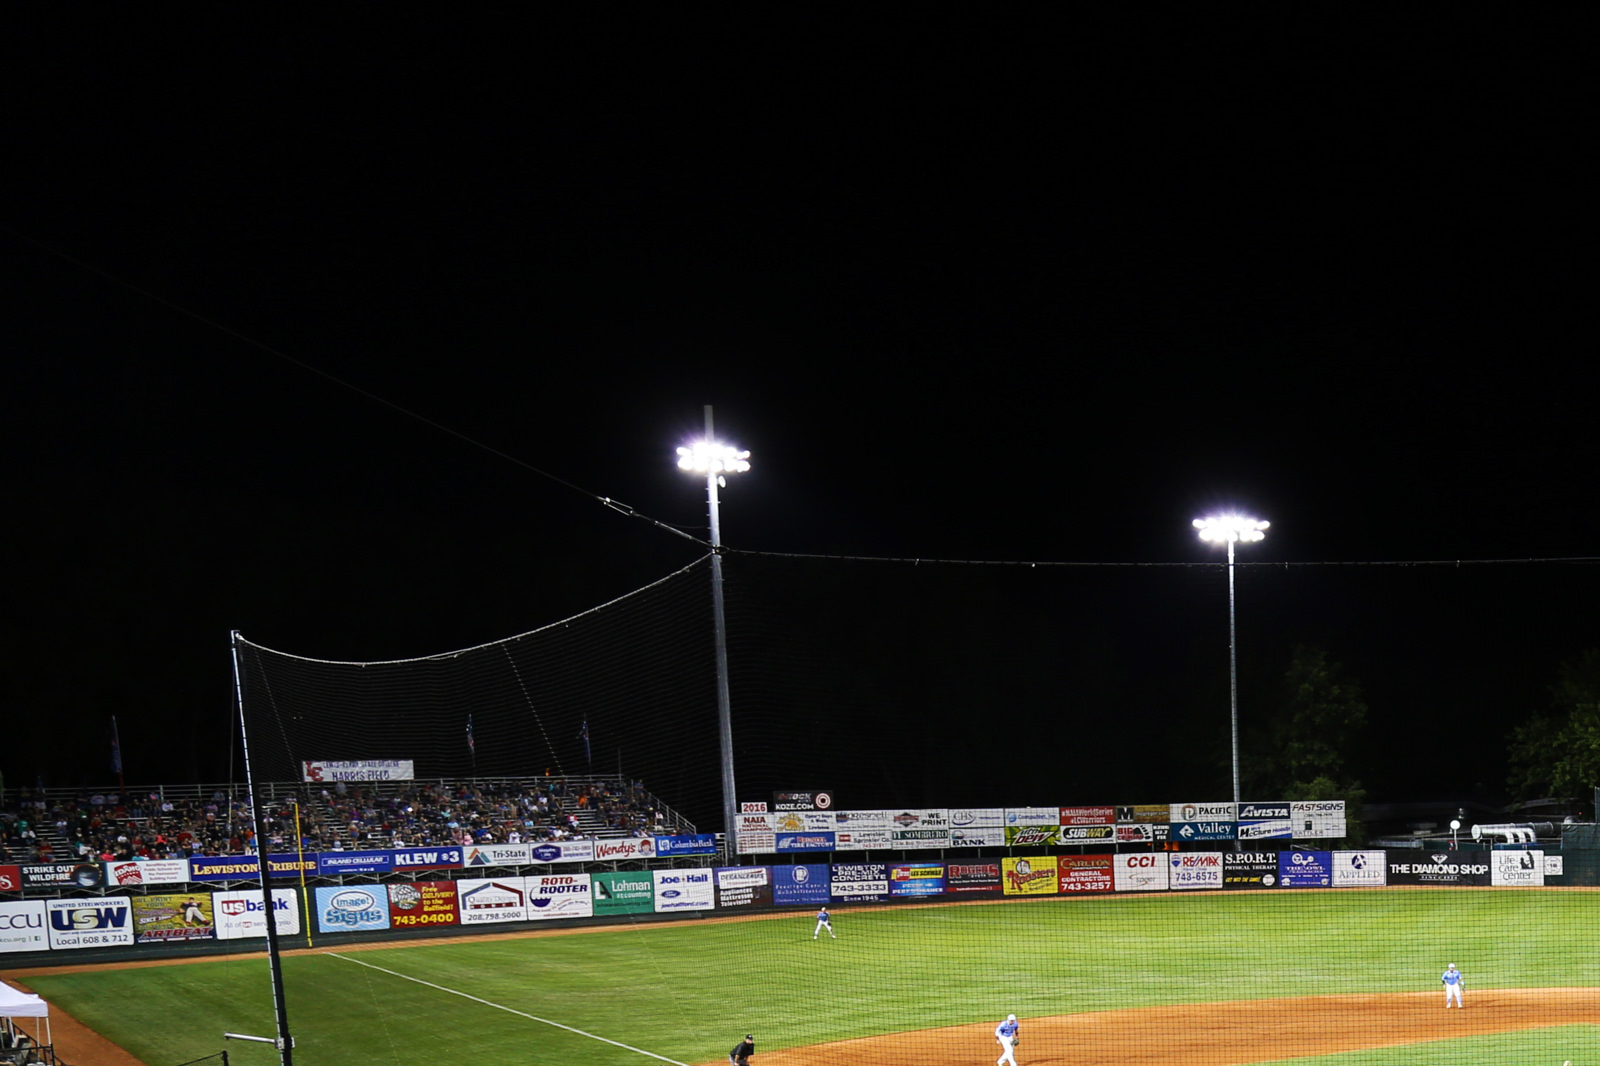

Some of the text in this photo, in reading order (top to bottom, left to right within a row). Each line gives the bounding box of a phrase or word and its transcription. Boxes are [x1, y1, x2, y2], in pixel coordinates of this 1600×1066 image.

[332, 770, 390, 781] HARRIS FIELD
[743, 804, 766, 812] 2016
[1199, 807, 1232, 815] PACIFIC
[1240, 805, 1289, 817] AVISTA
[1292, 803, 1344, 811] FASTSIGNS
[953, 812, 975, 820] CHS
[1066, 828, 1110, 838] SUBWAY
[1197, 823, 1231, 834] Valley
[670, 840, 698, 848] Columbia
[493, 850, 526, 858] Tri-State
[596, 841, 636, 858] Wendy's
[395, 852, 438, 865] KLEW
[1060, 858, 1111, 869] CARLTON
[1127, 856, 1155, 867] CCI
[1183, 856, 1220, 867] RE/MAX
[1225, 853, 1276, 864] S.P.O.R.T.
[1499, 856, 1516, 864] Life
[23, 865, 75, 874] STRIKE OUT
[193, 863, 258, 875] LEWISTON
[832, 864, 885, 872] LEWISTON
[948, 865, 999, 879] ROGERS
[1390, 864, 1488, 875] THE DIAMOND SHOP
[29, 873, 71, 881] WILDFIRE
[660, 874, 708, 884] Joe Hall
[1176, 872, 1218, 881] 743-6575
[1339, 870, 1380, 878] APPLIED
[541, 877, 578, 885] ROTO-
[540, 885, 588, 894] ROOTER
[611, 881, 650, 892] Lohman
[833, 884, 886, 892] 743-3333
[336, 897, 369, 908] image!
[51, 907, 128, 931] USW
[326, 909, 383, 925] Signs
[393, 913, 454, 925] 743-0400
[468, 912, 520, 921] 208.798.5000
[143, 928, 211, 938] ARTBEAT
[56, 937, 80, 946] Local
